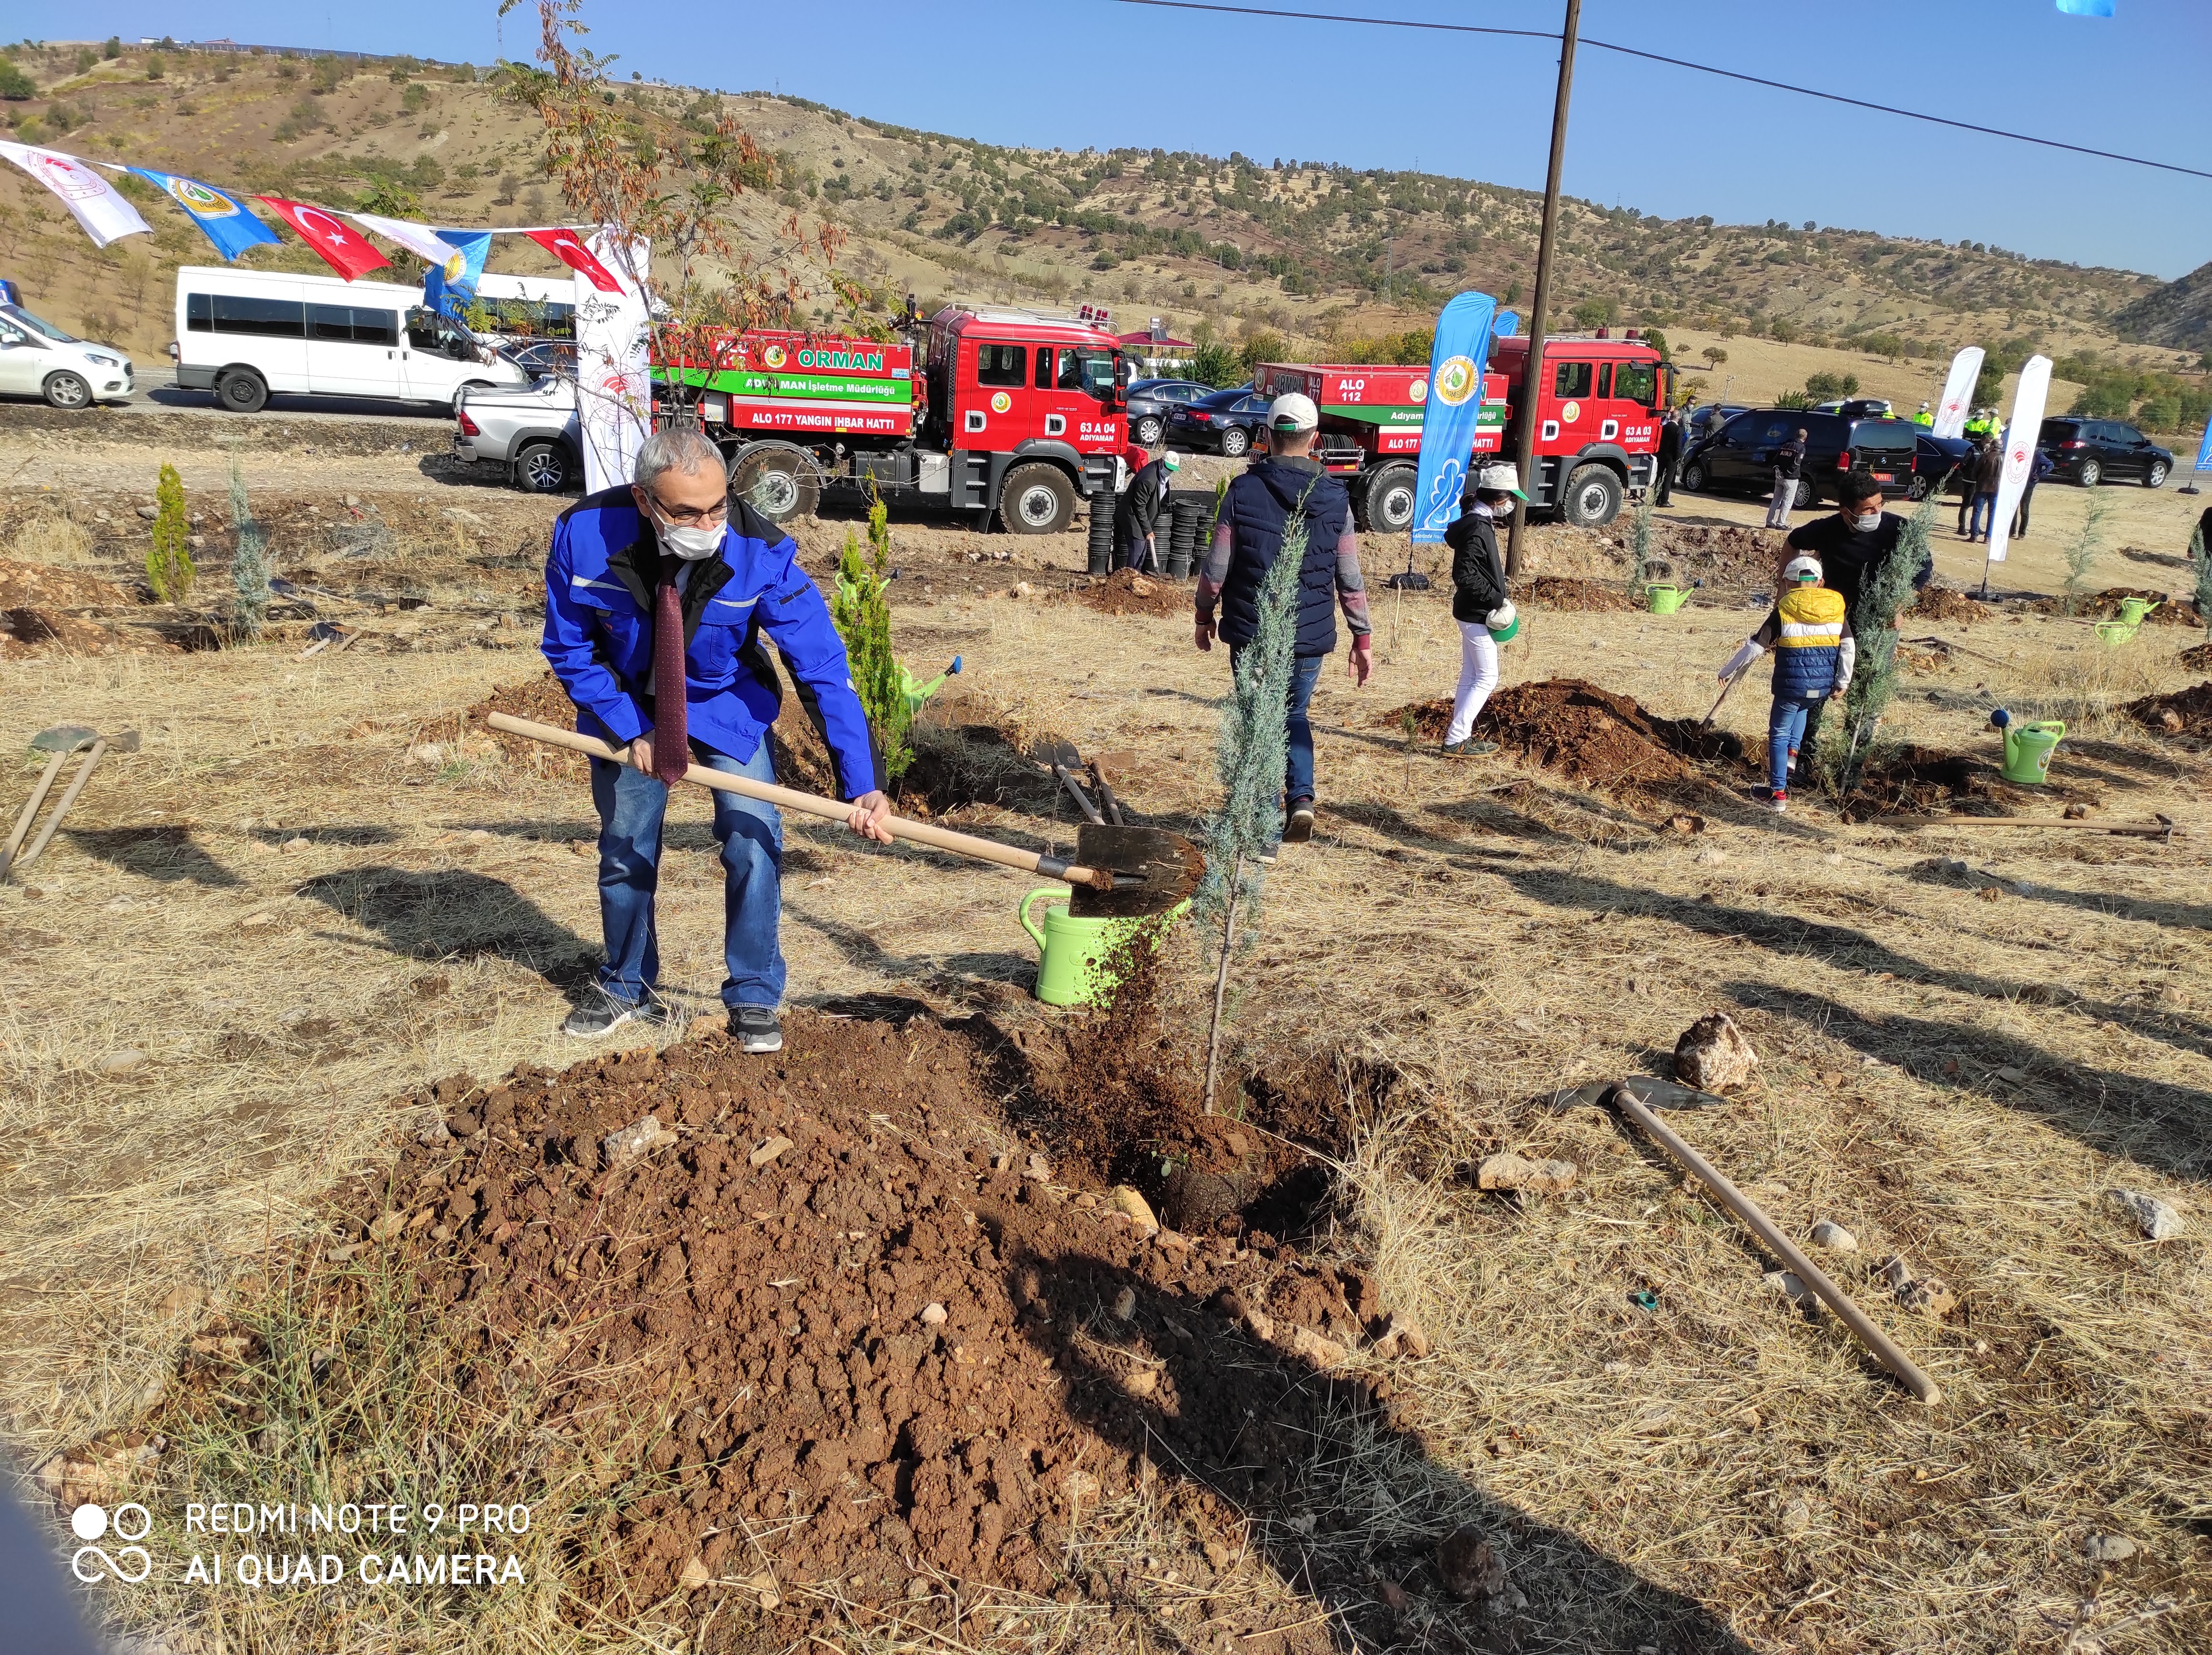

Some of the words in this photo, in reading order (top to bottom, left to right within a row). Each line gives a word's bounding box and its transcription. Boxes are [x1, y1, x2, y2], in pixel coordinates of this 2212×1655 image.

[798, 349, 882, 371] ORMAN
[745, 378, 806, 390] ADMAN
[809, 380, 843, 392] İşletme
[846, 384, 895, 397] Müdürlüğü
[1274, 373, 1305, 395] ORMAN
[1309, 376, 1321, 388] ALO
[1339, 379, 1365, 390] ALO
[1309, 388, 1320, 401] 177
[1342, 392, 1361, 401] 112
[752, 413, 772, 424] ALO
[775, 414, 792, 424] 177
[795, 415, 831, 426] YANGIN
[867, 419, 894, 429] HATTI
[1391, 412, 1423, 421] Adıyam
[1080, 422, 1092, 433] 63
[1094, 423, 1101, 433] A
[1104, 423, 1115, 433] 04
[1626, 426, 1635, 436] 63
[1636, 426, 1641, 436] A
[1643, 426, 1652, 435] 03
[1388, 439, 1403, 449] ALO
[1405, 439, 1417, 449] 177
